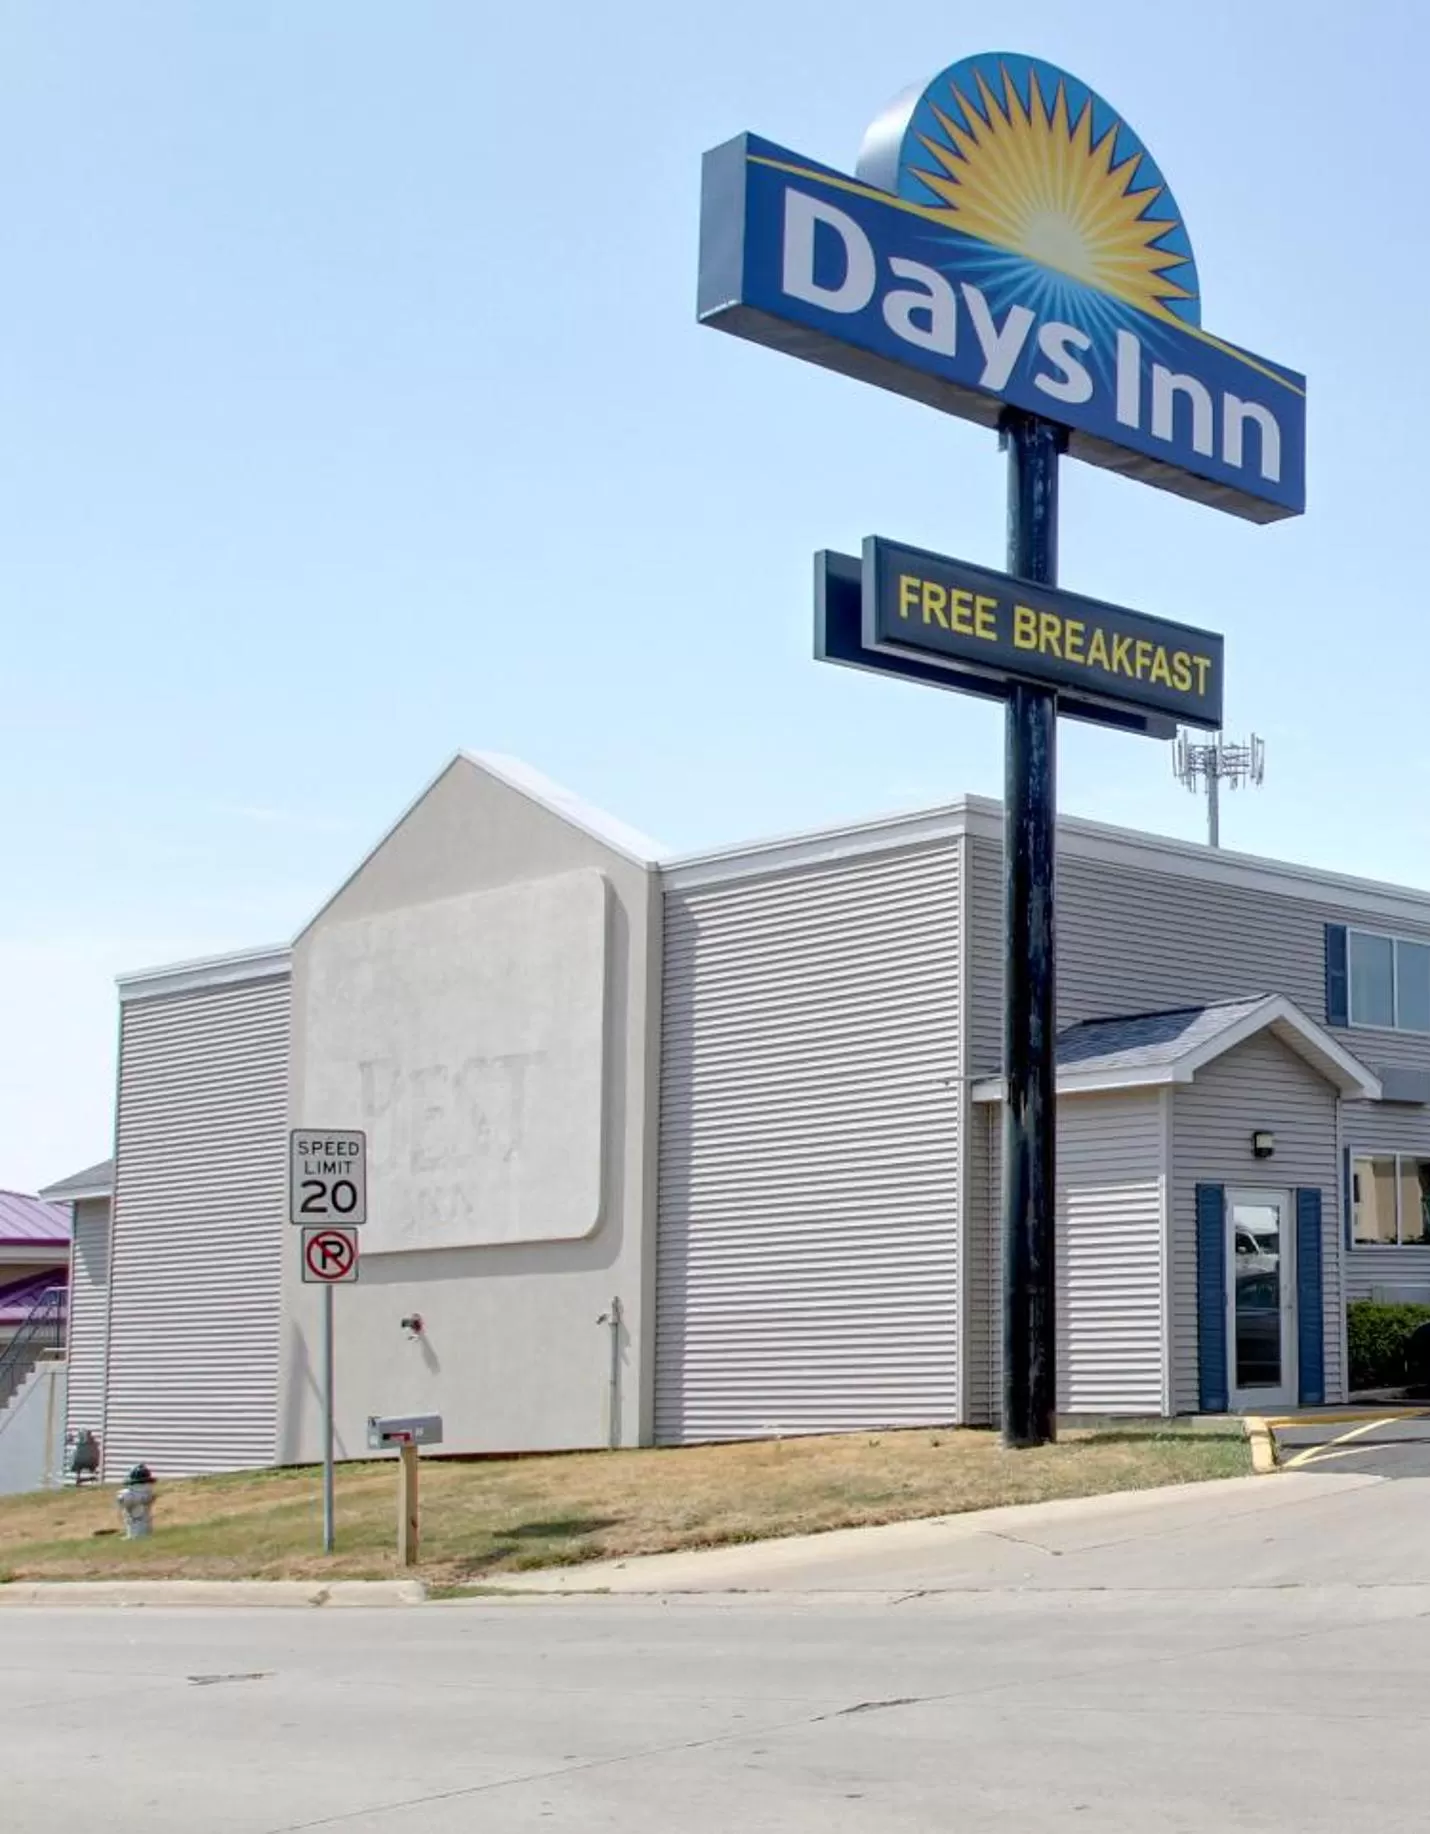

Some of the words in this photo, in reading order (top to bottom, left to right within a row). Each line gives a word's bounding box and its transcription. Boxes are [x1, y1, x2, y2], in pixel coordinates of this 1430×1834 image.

[782, 186, 1093, 404] Days
[1116, 328, 1281, 484] Inn
[899, 574, 997, 642] FREE
[1013, 605, 1211, 696] BREAKFAST
[297, 1141, 360, 1156] SPEED
[304, 1160, 352, 1175] LIMIT
[300, 1179, 357, 1213] 20
